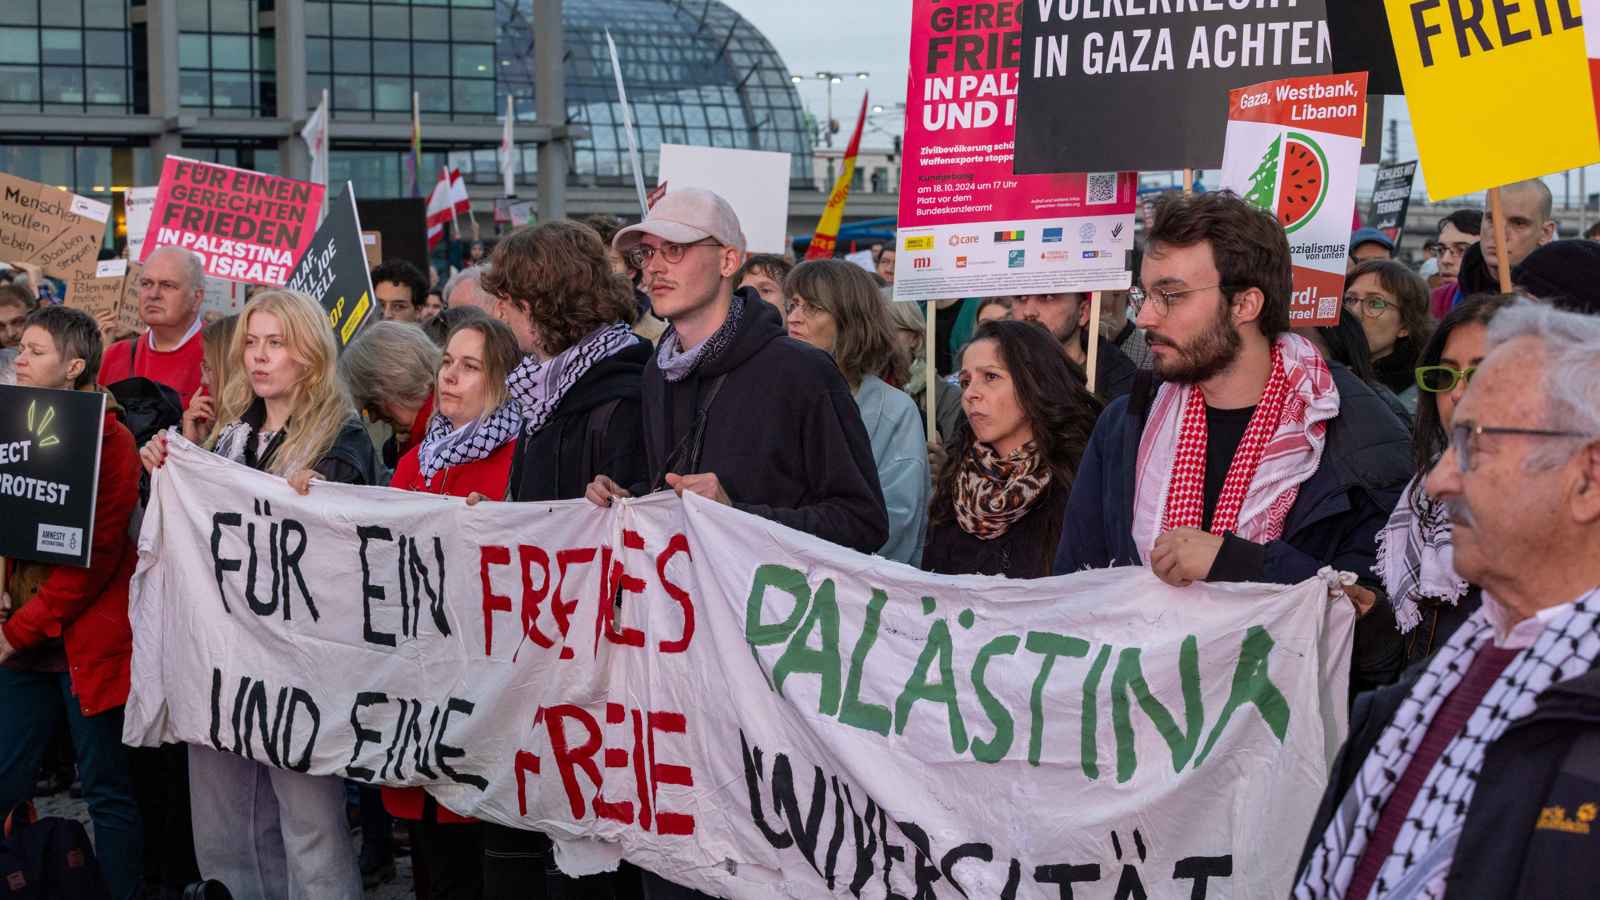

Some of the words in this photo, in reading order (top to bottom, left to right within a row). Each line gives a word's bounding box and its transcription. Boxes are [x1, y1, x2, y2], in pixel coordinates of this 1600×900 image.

[1034, 35, 1068, 78] IN
[1082, 28, 1174, 75] GAZA
[1187, 20, 1333, 69] ACHTEN
[924, 77, 953, 101] IN
[1240, 91, 1271, 110] Gaza,
[1276, 80, 1358, 102] Westbank,
[923, 101, 998, 131] UND
[1291, 104, 1357, 121] Libanon
[920, 143, 993, 155] Zivilbevölkerung
[920, 155, 984, 166] Waffenexporte
[174, 162, 227, 189] FÜR
[231, 172, 312, 204] EINEN
[993, 181, 1001, 189] 17
[1003, 180, 1018, 189] Uhr
[5, 186, 81, 225] Menschen
[170, 184, 305, 225] GERECHTEN
[916, 204, 992, 216] Bundeskanzleramt
[917, 197, 936, 205] Platz
[953, 194, 972, 202] dem
[2, 210, 50, 234] wollen
[162, 203, 302, 249] FRIEDEN
[157, 228, 179, 246] IN
[182, 232, 293, 267] PALÄSTINA
[318, 238, 337, 277] JOE
[1322, 252, 1344, 260] unten
[208, 254, 287, 286] ISRAEL
[311, 267, 336, 301] ELL
[1291, 287, 1317, 304] rd!
[0, 474, 70, 505] ROTEST
[211, 499, 319, 622] FÜR
[357, 525, 452, 647] EIN
[745, 563, 1290, 784] PALÄSTINA
[209, 668, 320, 772] UND
[347, 692, 488, 792] EINE
[514, 703, 695, 835] FREIE
